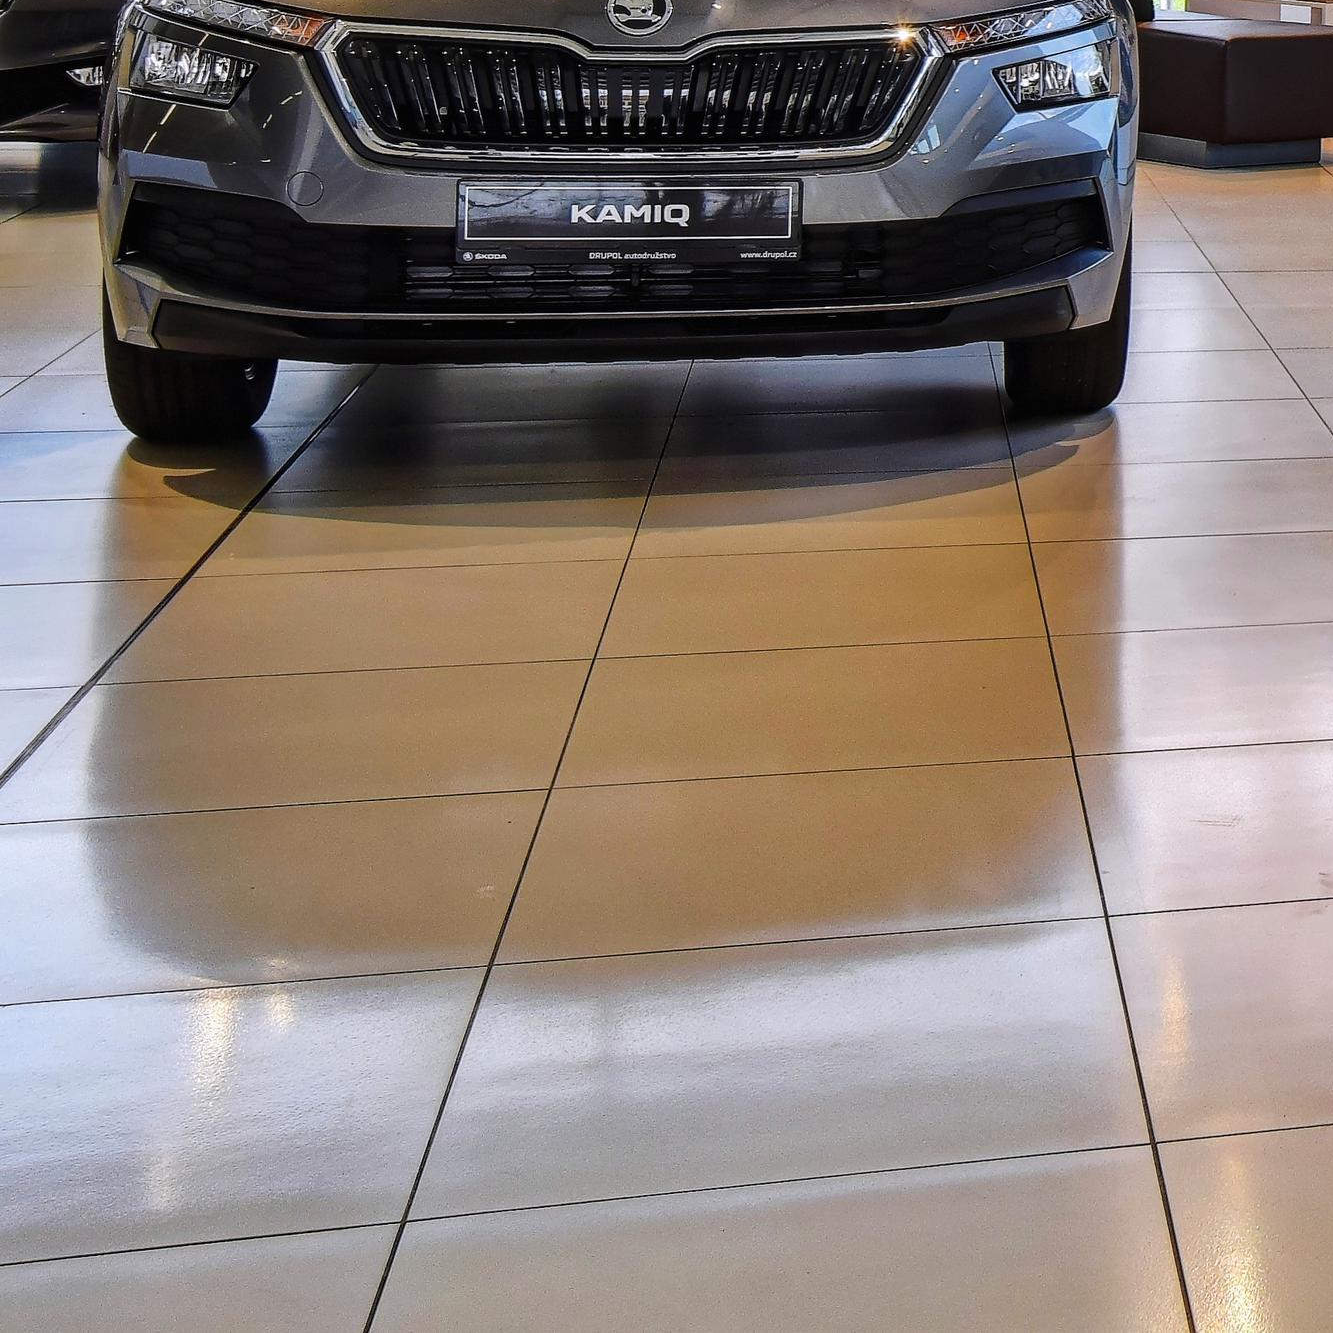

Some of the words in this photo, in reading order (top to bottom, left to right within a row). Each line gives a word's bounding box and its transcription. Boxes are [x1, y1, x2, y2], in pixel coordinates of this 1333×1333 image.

[570, 203, 690, 227] KAMIQ
[589, 251, 623, 260] DRUPOL
[623, 251, 677, 260] autodružstvo
[740, 250, 798, 260] www.drupol.cz
